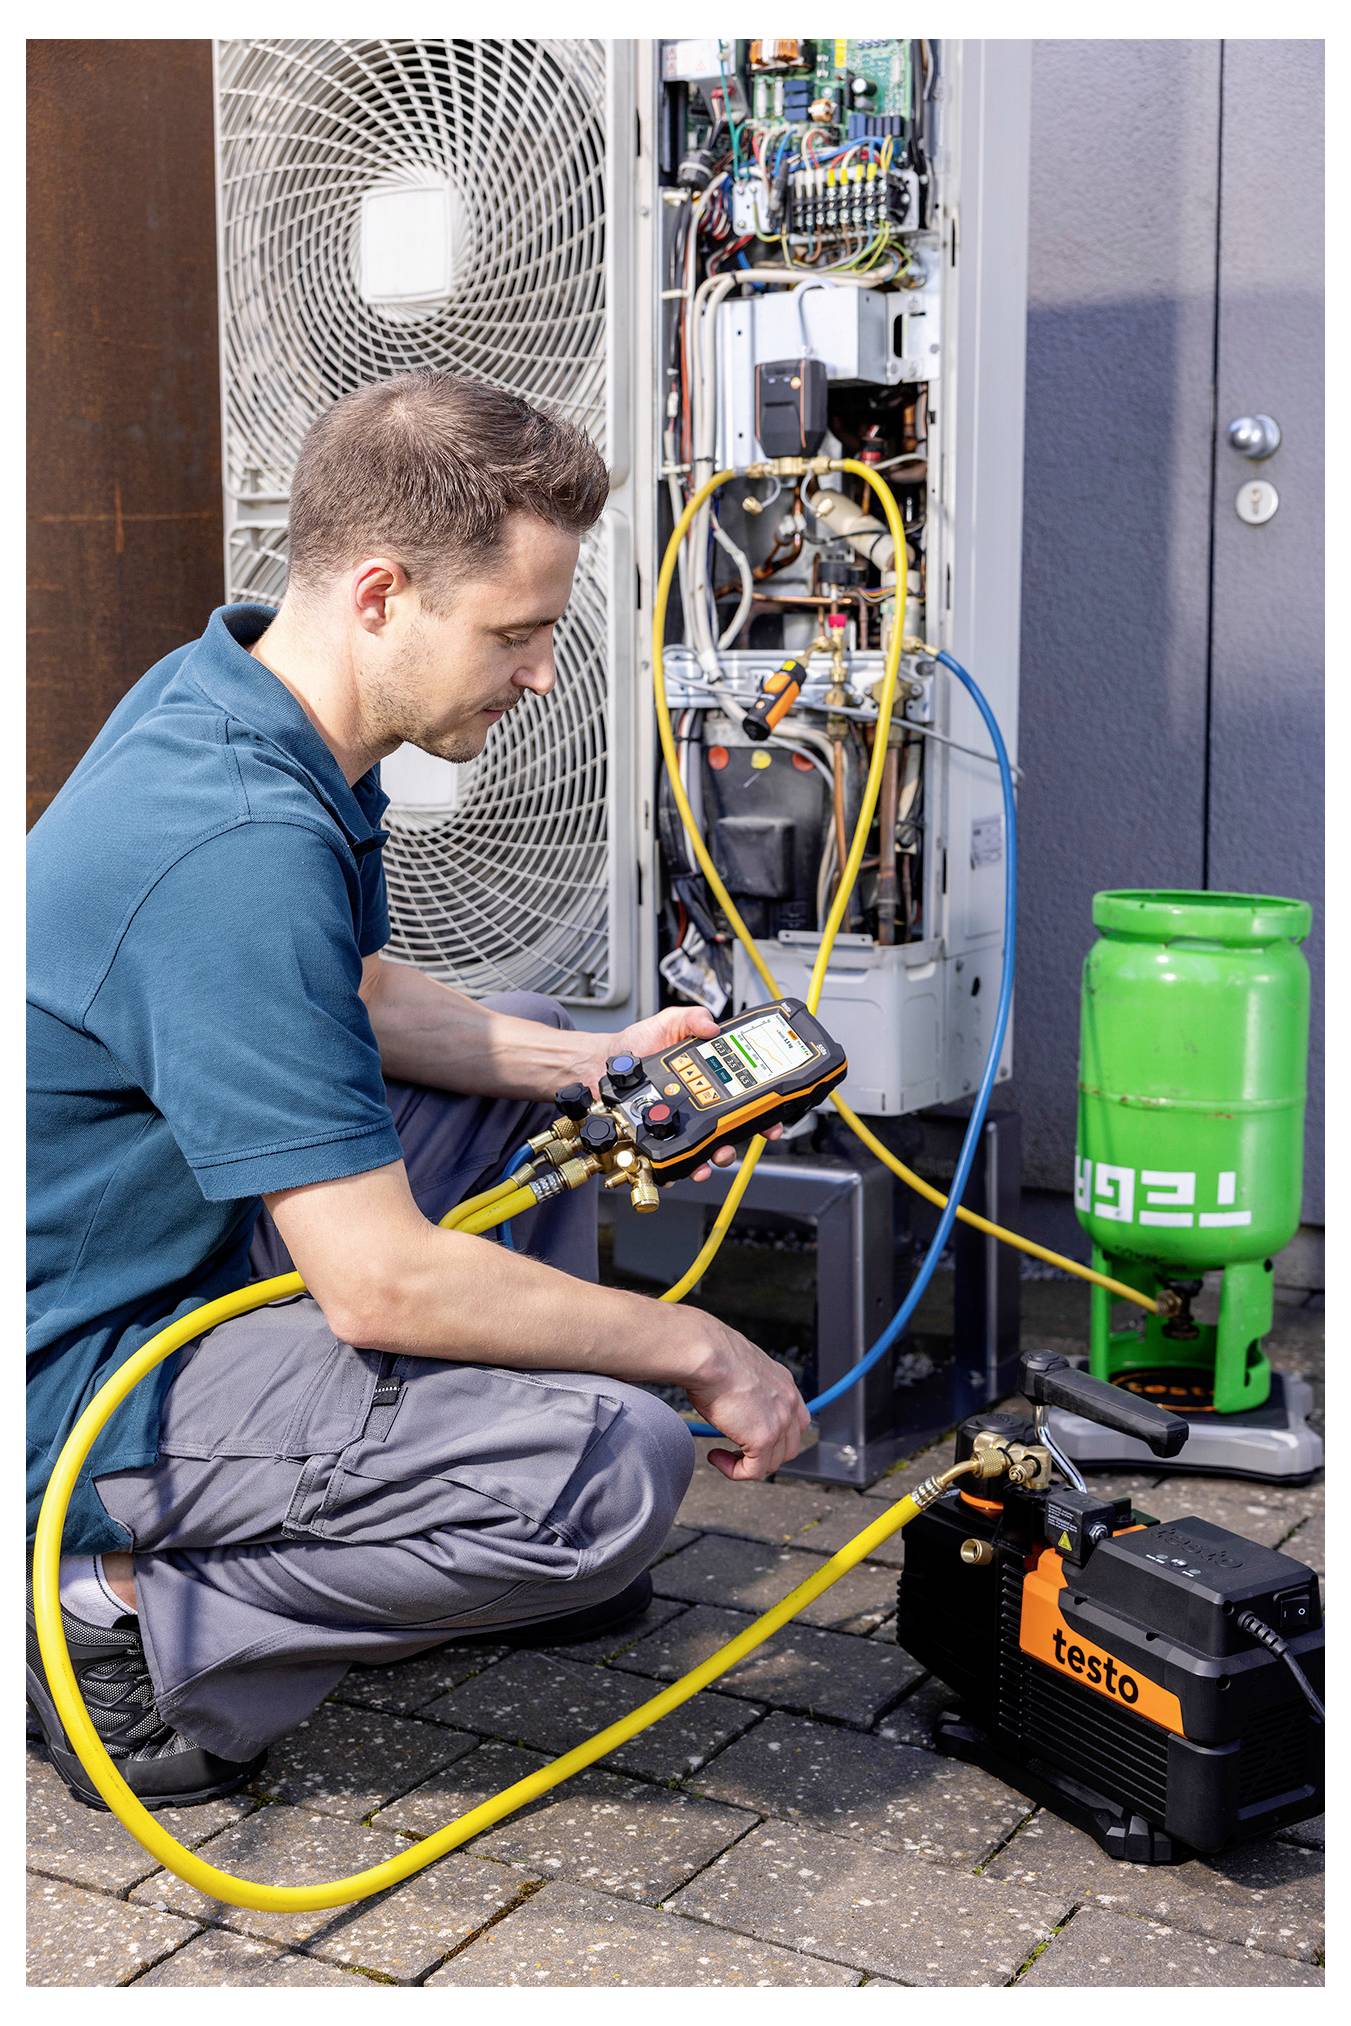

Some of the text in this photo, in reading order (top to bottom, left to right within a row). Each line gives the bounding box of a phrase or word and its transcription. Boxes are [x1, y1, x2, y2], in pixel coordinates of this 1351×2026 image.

[1074, 1155, 1252, 1228] TEGA
[1127, 1381, 1215, 1397] test
[1052, 1627, 1139, 1704] testo
